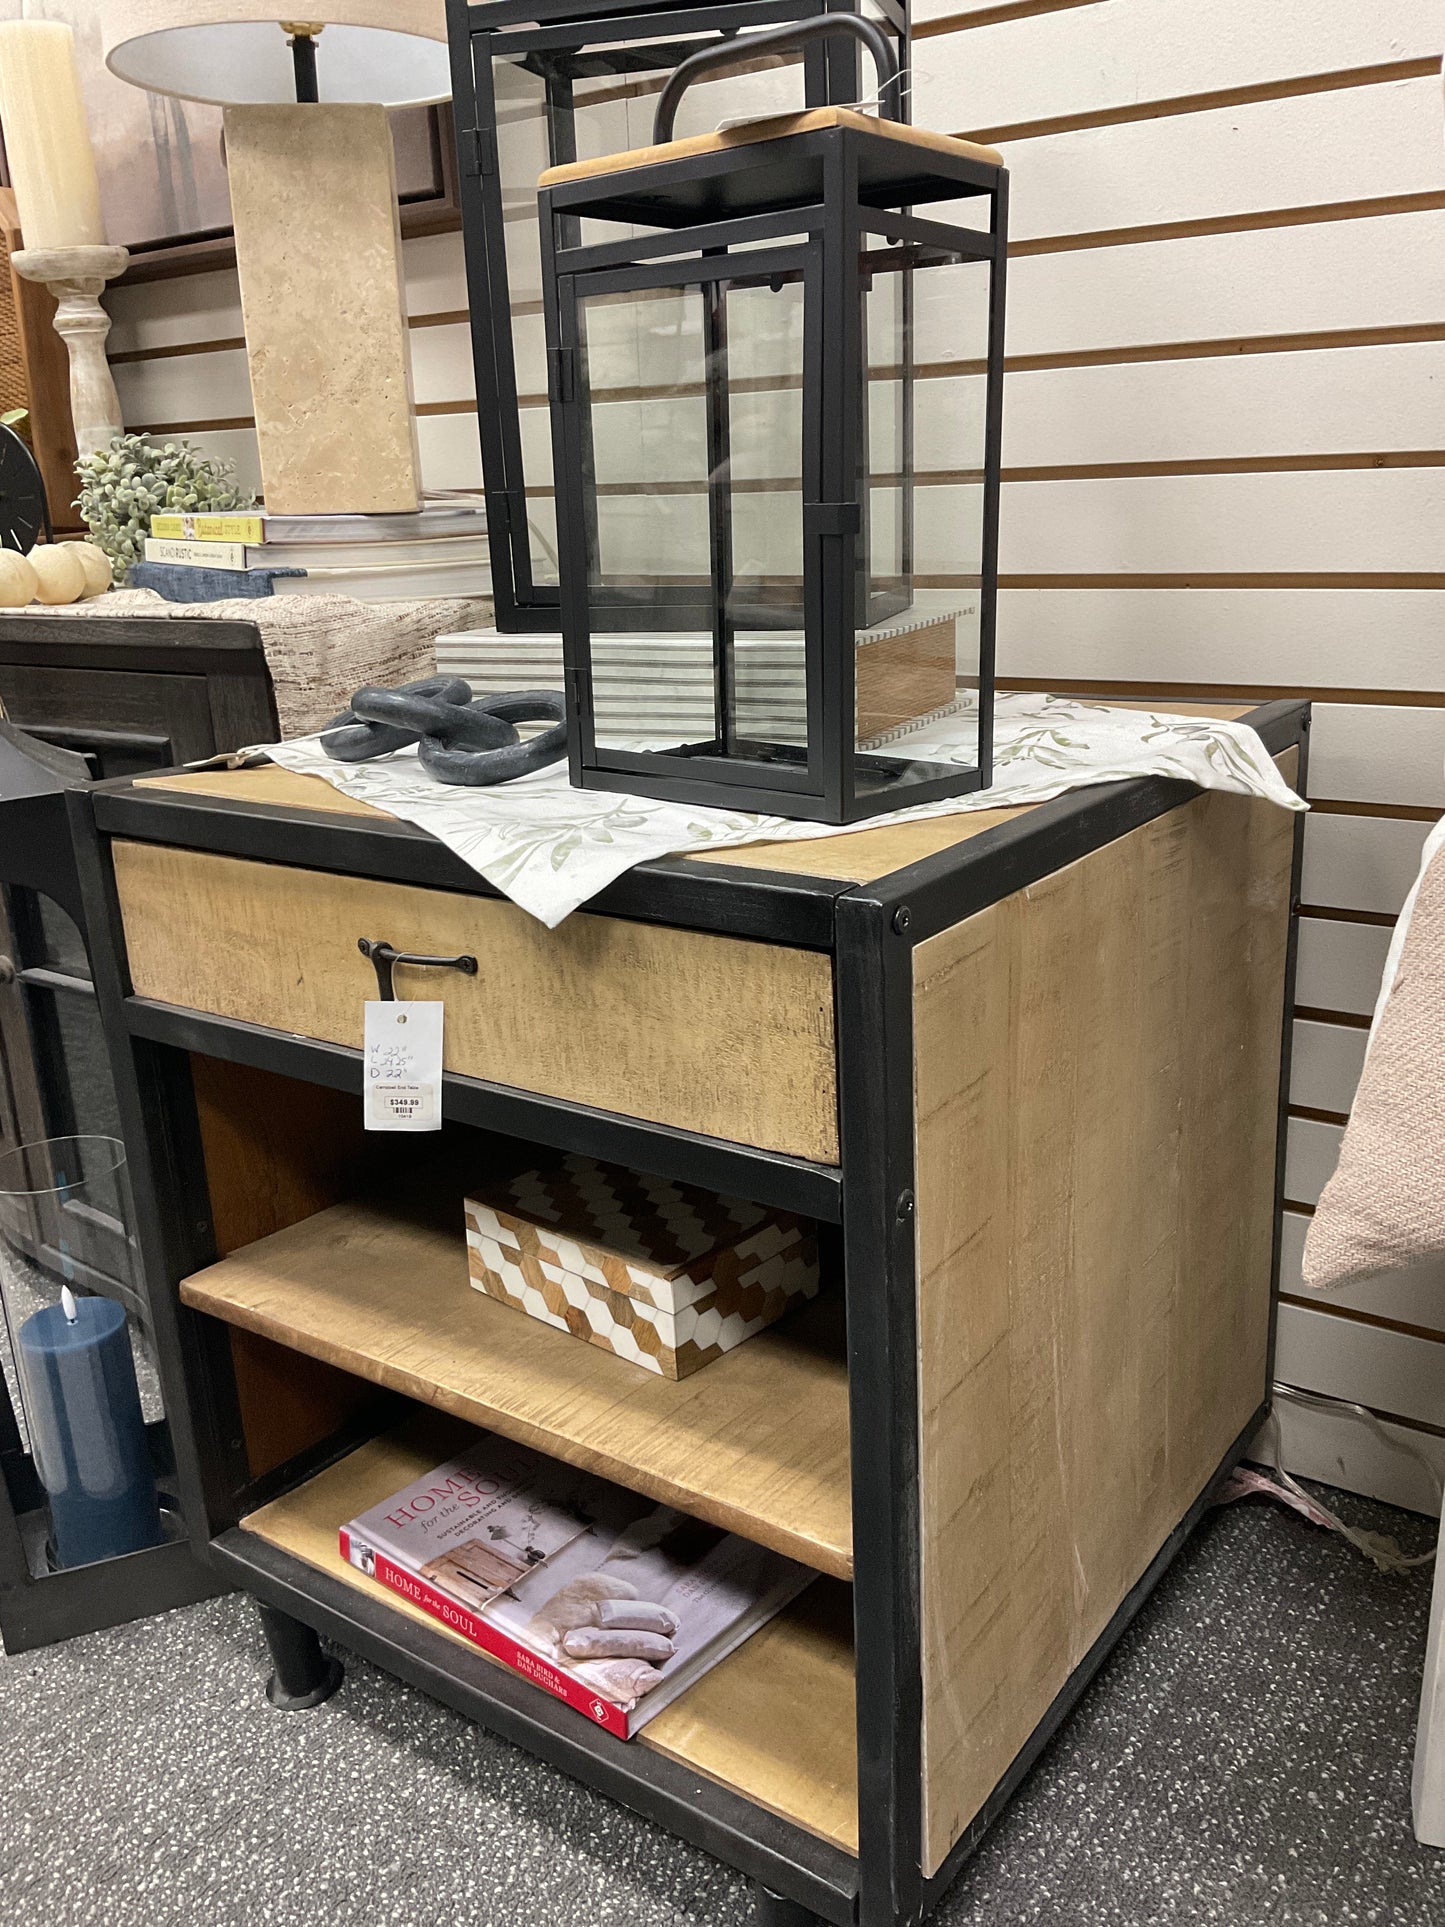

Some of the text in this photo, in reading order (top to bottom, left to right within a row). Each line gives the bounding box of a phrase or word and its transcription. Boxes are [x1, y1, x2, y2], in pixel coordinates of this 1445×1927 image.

[370, 1067, 380, 1078] D
[384, 1466, 482, 1528] HOME
[421, 1458, 540, 1534] for the SOUL
[437, 1509, 482, 1539] SUSTAINABLE
[482, 1499, 498, 1511] AND
[454, 1508, 497, 1537] DECORATING
[498, 1498, 512, 1510] AND
[385, 1567, 421, 1600] HOME
[443, 1605, 477, 1637] SOUL
[516, 1651, 535, 1668] SARA
[536, 1663, 554, 1680] BIRD
[517, 1659, 568, 1697] DAN DUCHARS
